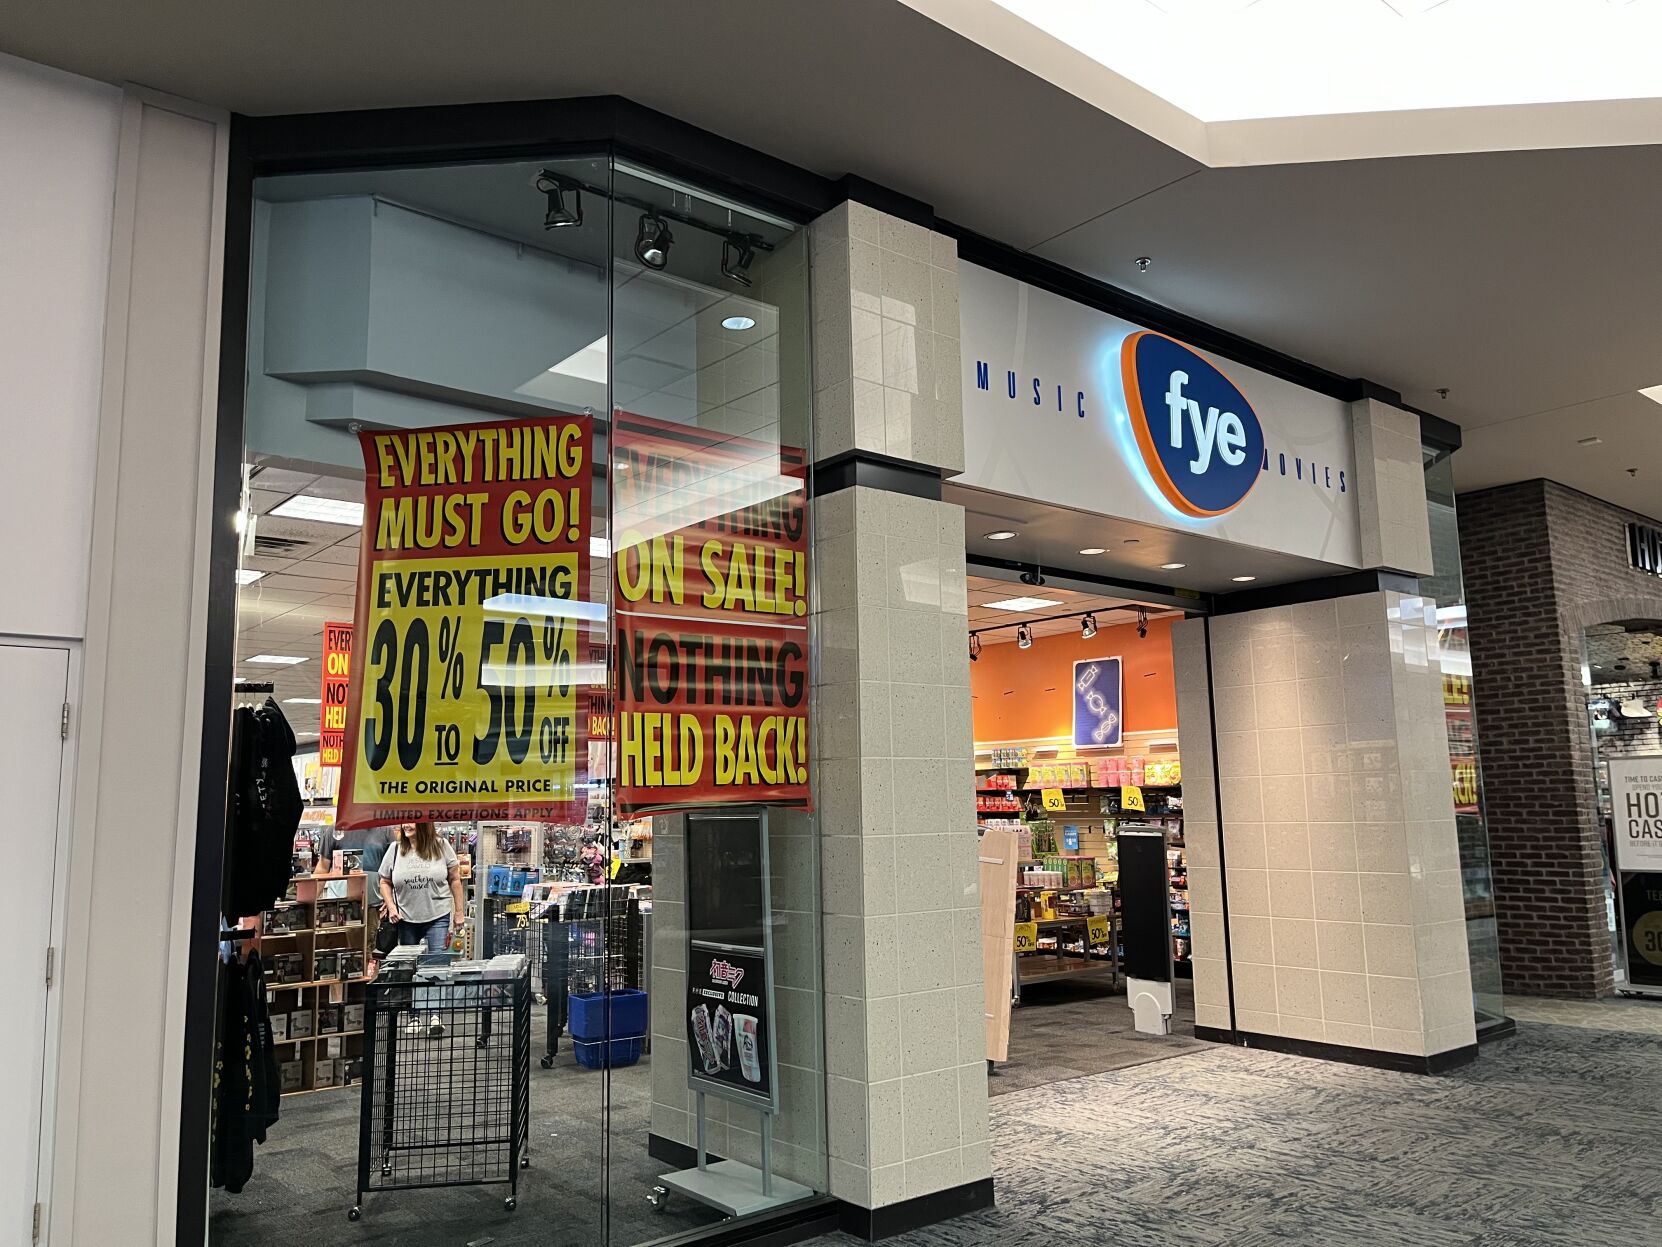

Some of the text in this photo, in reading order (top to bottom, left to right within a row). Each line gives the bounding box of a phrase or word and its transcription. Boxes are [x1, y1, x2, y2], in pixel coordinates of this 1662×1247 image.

[976, 360, 1085, 419] MUSIC
[1164, 370, 1247, 475] fye
[374, 424, 583, 488] EVERYTHING
[376, 488, 581, 550] MUST GO!
[376, 565, 573, 609] EVERYTHING
[617, 528, 807, 616] ON SALE!
[327, 652, 349, 675] ON
[328, 629, 354, 652] EVER
[364, 615, 571, 772] 30% TO 50% OFF
[618, 628, 804, 708] NOTHING
[620, 711, 808, 788] HELD BACK!
[379, 778, 551, 794] THE ORIGINAL PRICE
[1624, 775, 1639, 783] TIME
[1640, 775, 1648, 783] TO
[372, 807, 555, 821] LIMITED EXCEPTIONS APPLY
[1625, 791, 1662, 819] HO
[728, 991, 758, 1007] COLLECTION
